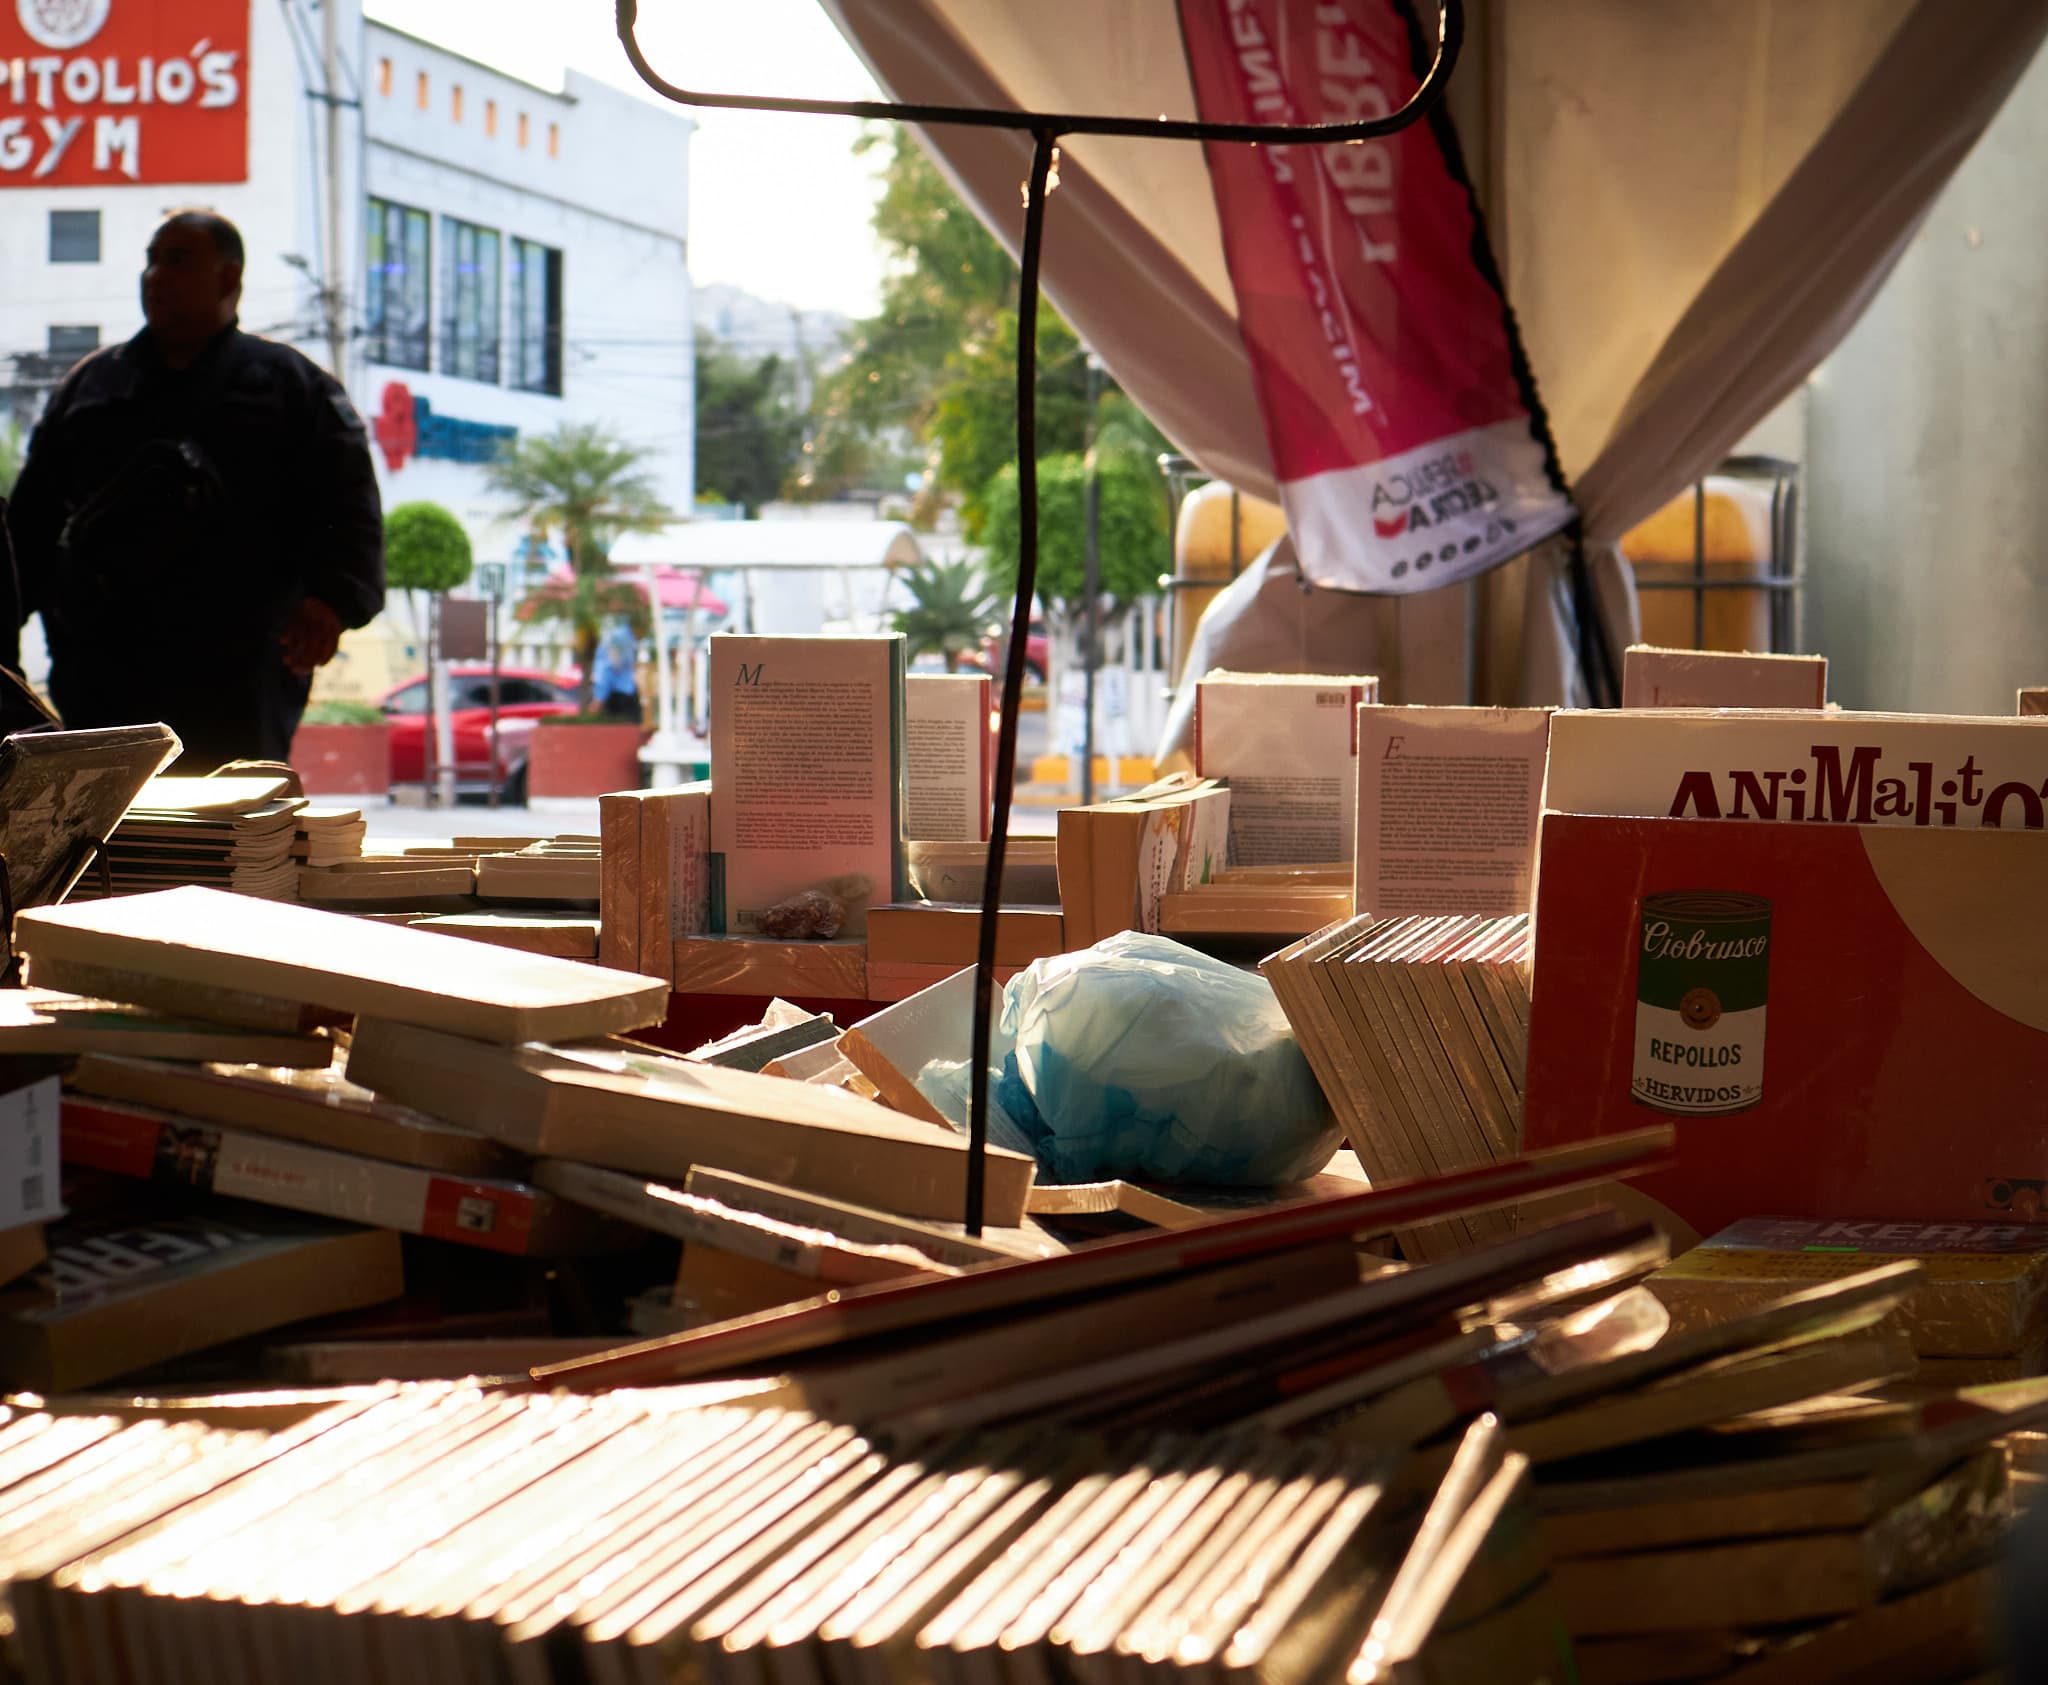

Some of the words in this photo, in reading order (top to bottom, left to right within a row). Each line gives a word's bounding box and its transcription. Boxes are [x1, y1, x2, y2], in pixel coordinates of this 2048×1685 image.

[0, 115, 142, 181] GYM
[1650, 1038, 1742, 1068] REPOLLOS
[1645, 1077, 1742, 1104] HERVIDOS
